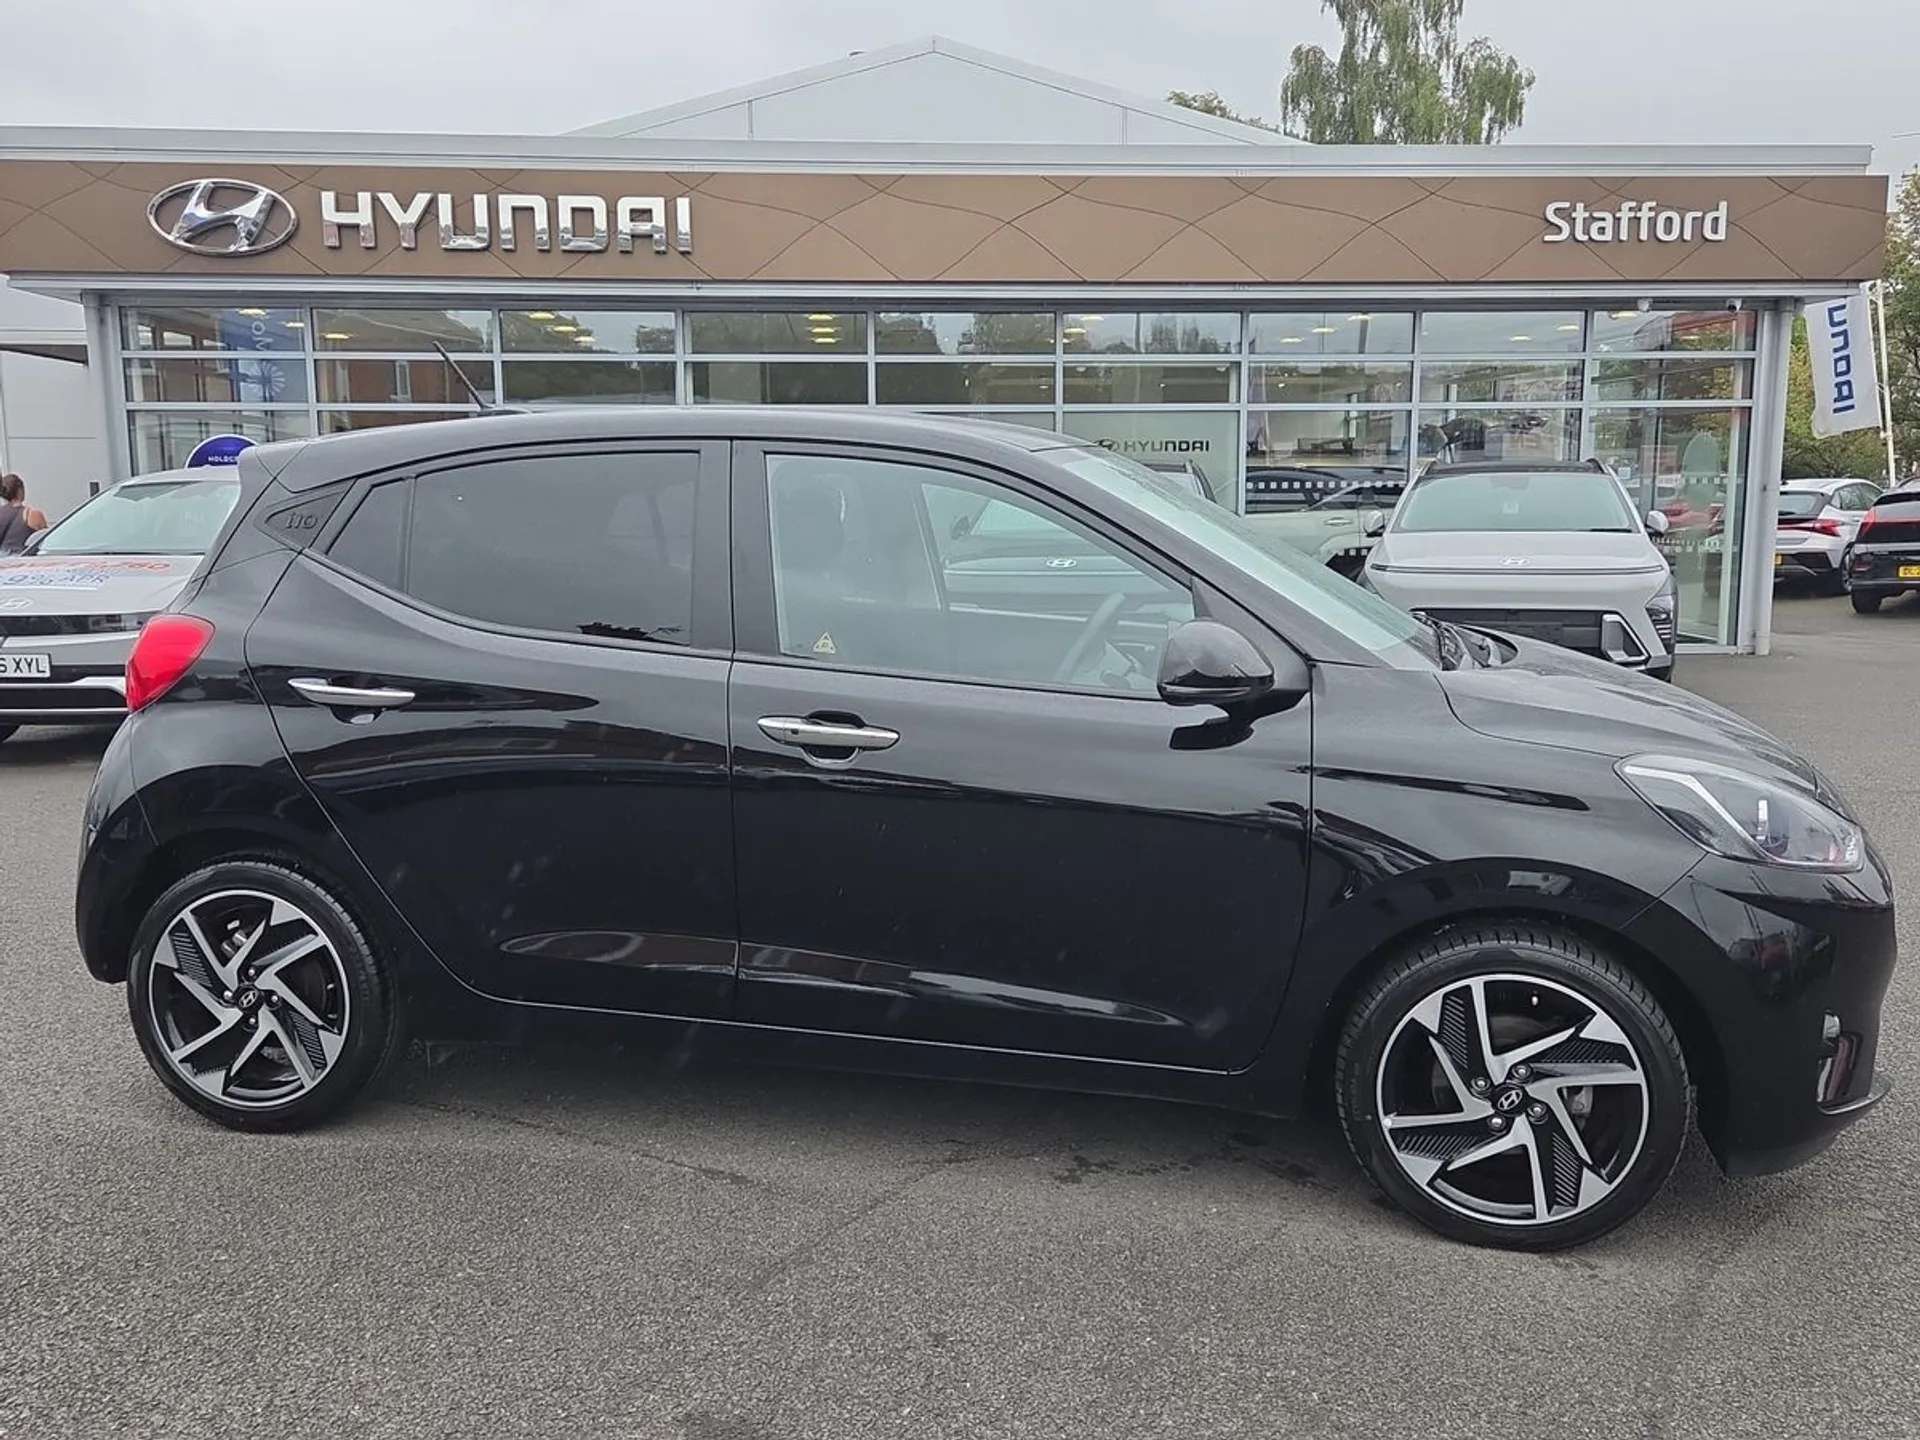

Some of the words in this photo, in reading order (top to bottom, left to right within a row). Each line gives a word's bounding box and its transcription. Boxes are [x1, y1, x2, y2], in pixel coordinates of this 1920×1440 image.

[321, 191, 693, 254] HYUNDAI
[1543, 200, 1728, 242] Stafford
[1123, 440, 1210, 452] HYUNDAI
[285, 511, 319, 530] i10
[12, 657, 46, 673] XYL
